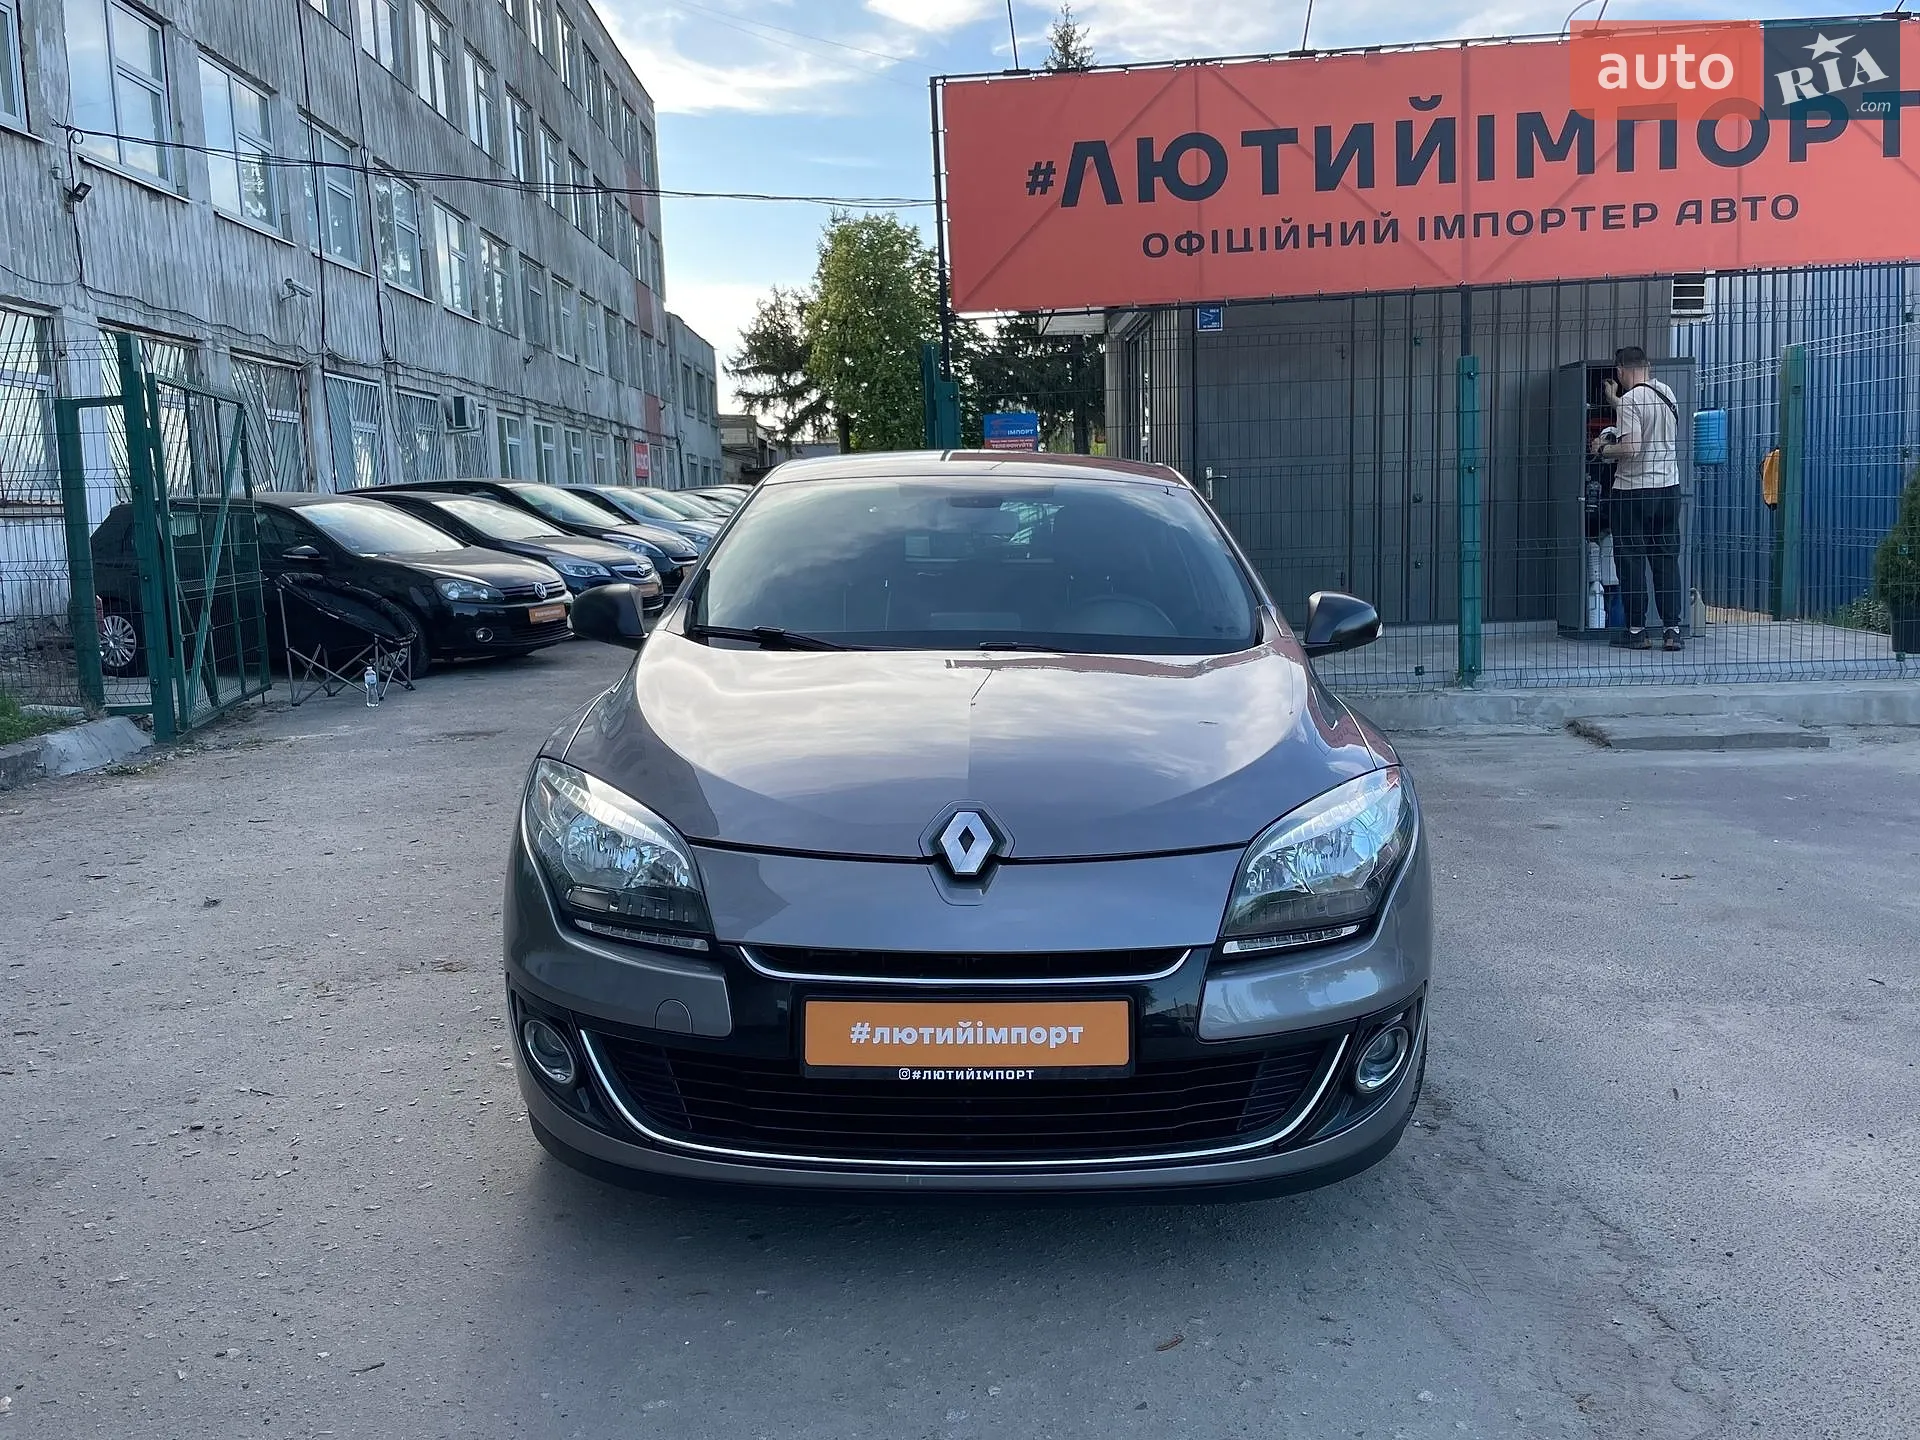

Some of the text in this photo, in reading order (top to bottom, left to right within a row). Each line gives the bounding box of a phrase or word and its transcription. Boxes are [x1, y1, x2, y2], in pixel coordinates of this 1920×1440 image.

[1025, 90, 1920, 208] #ЛЮТИЙІМПОРТ
[1142, 194, 1799, 258] ОФІЦІЙНИЙ ІМПОРТЕР АВТО
[850, 1020, 1083, 1049] #лютийімпорт
[912, 1068, 1035, 1080] #ЛЮТИЙІМПОРТ
